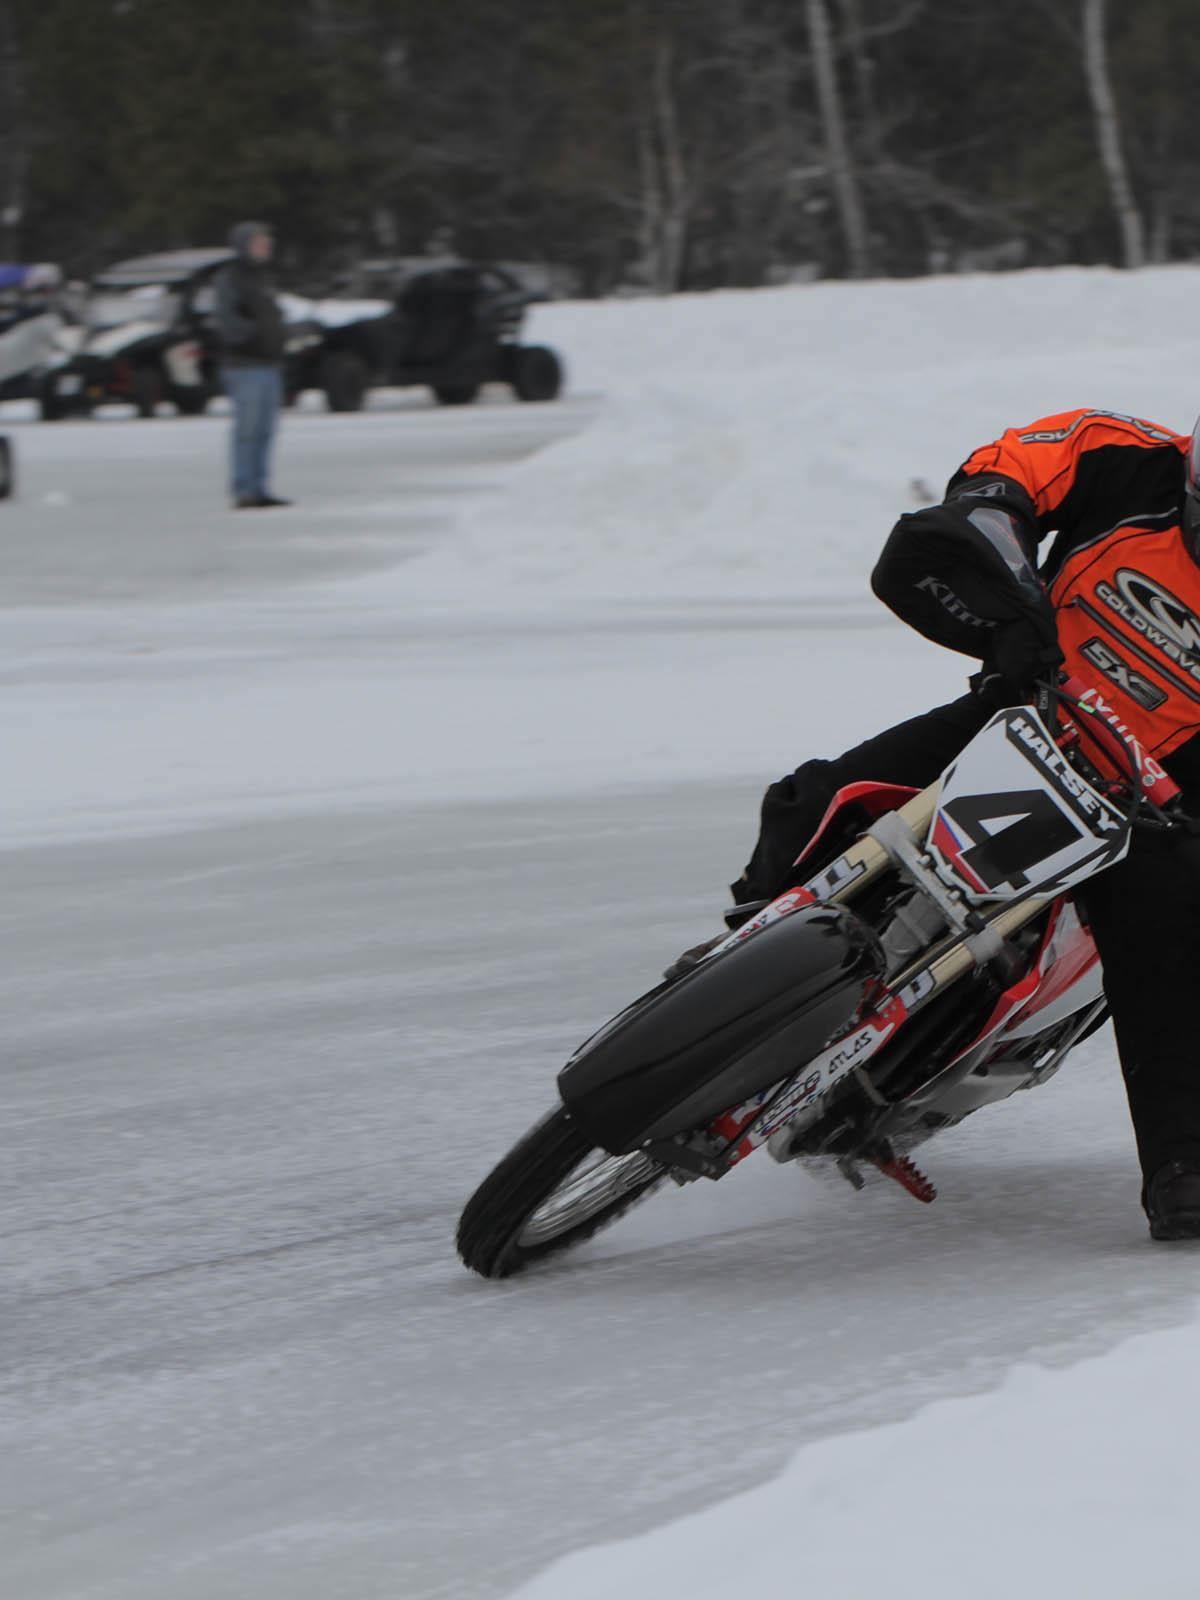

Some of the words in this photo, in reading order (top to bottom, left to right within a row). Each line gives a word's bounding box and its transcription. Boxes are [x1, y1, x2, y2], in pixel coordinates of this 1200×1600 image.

[1008, 716, 1121, 832] HALSEY
[941, 789, 1085, 892] 4
[829, 1031, 873, 1075] ATLAS
